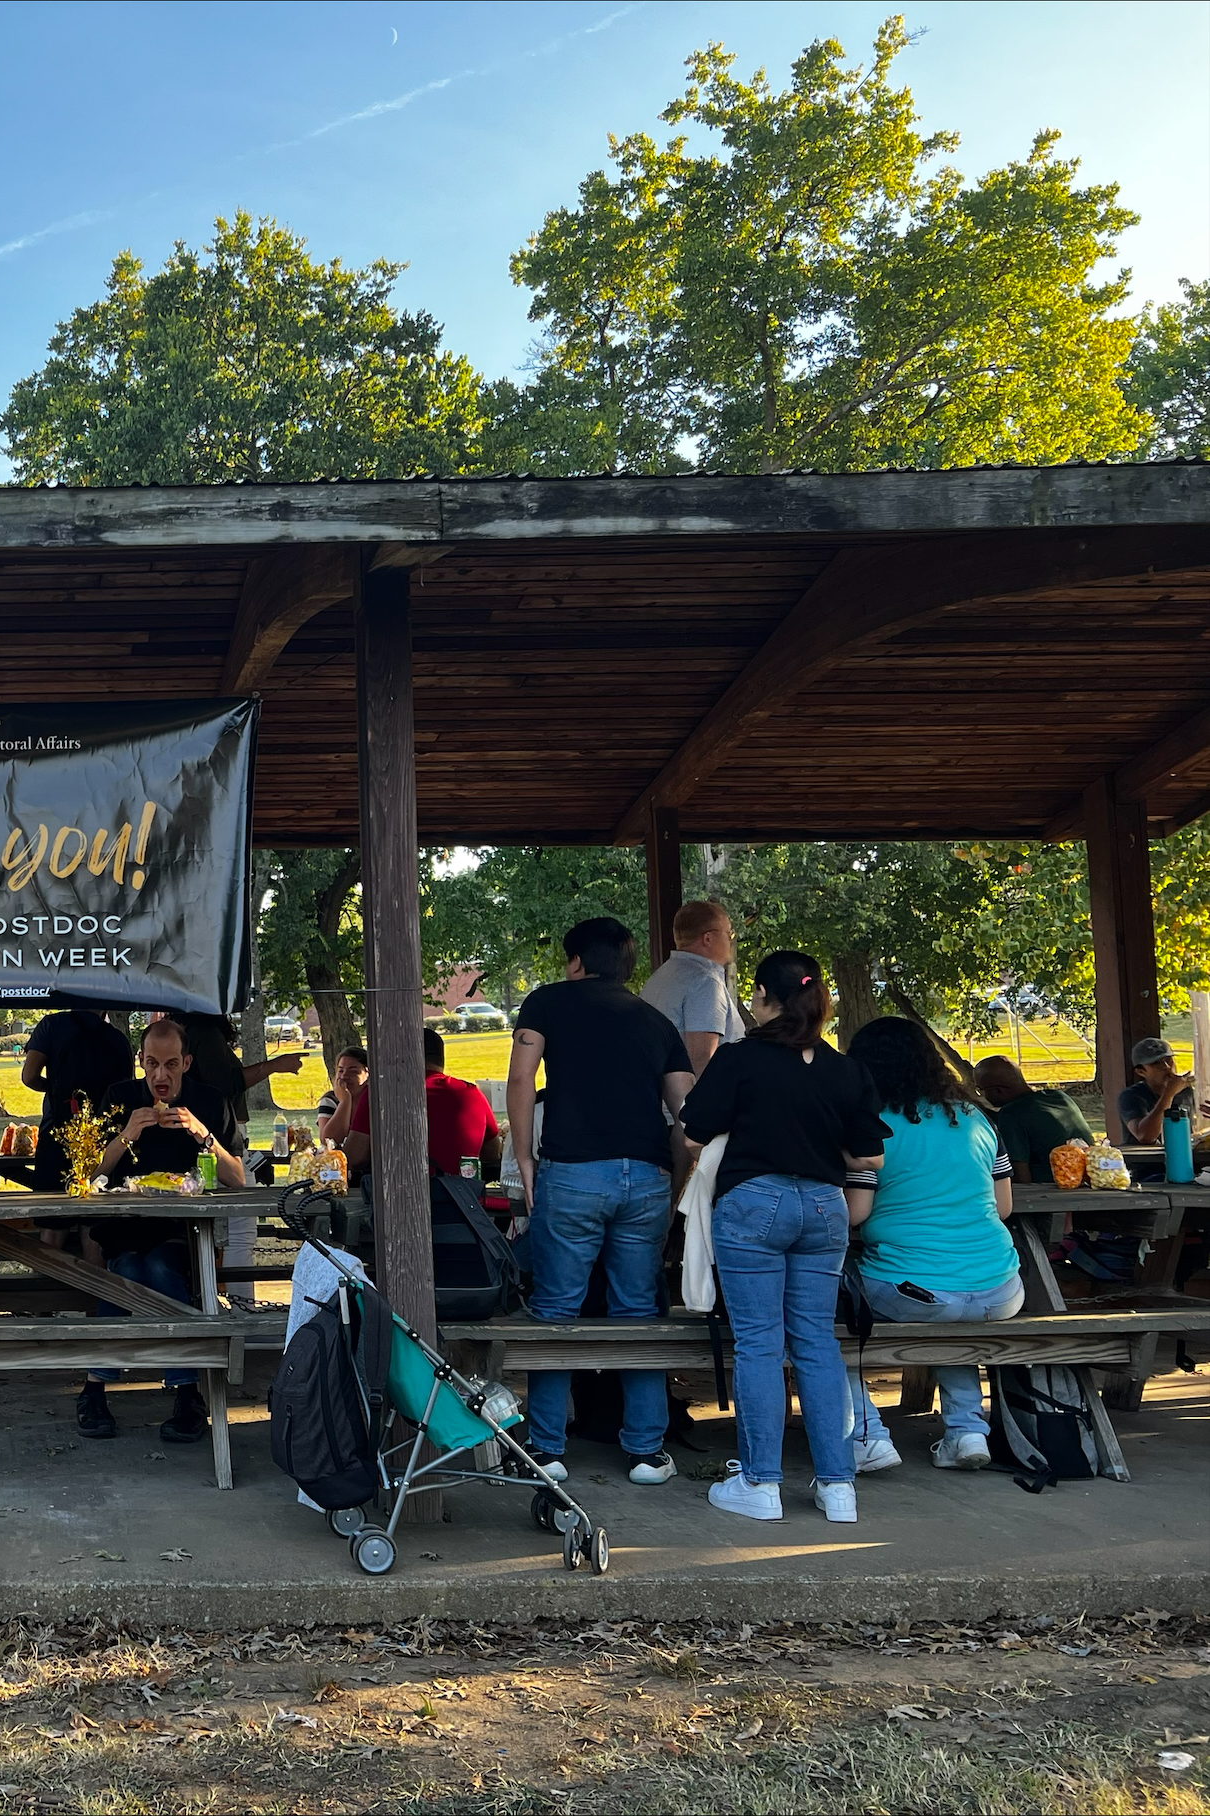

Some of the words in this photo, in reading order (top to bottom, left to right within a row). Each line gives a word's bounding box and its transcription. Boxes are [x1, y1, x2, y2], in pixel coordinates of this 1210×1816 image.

[35, 734, 82, 751] Affairs
[0, 800, 157, 893] you!
[37, 946, 133, 968] WEEK
